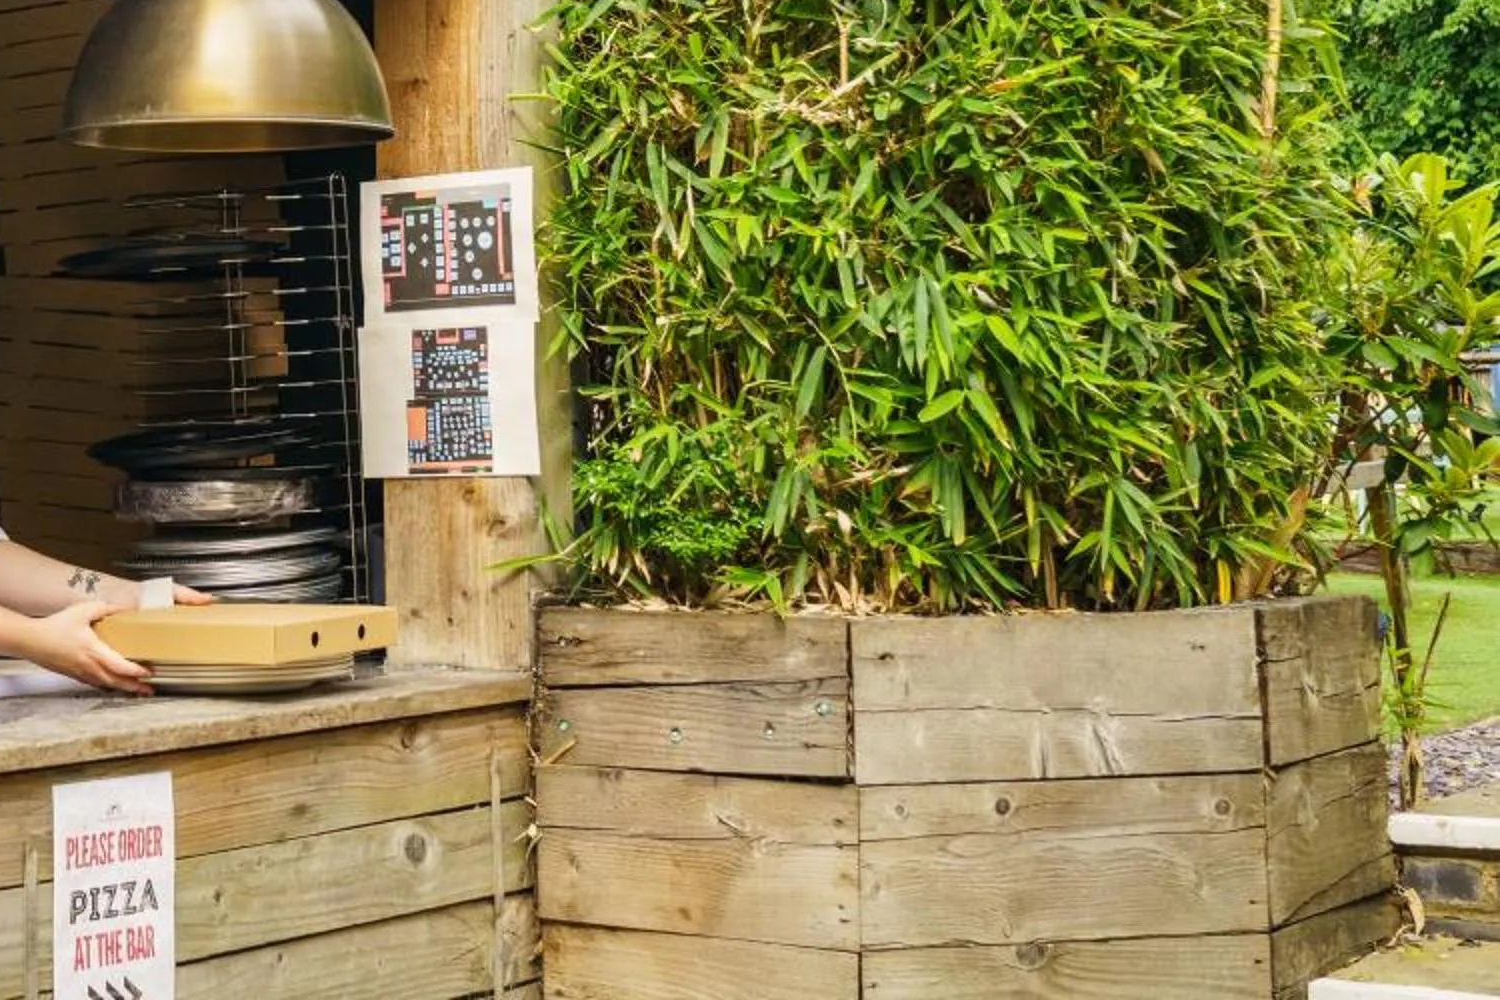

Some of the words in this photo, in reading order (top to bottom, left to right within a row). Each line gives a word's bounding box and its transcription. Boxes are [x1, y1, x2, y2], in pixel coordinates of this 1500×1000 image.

[65, 831, 116, 871] PLEASE
[117, 824, 164, 862] ORDER
[68, 878, 160, 925] PIZZA
[73, 935, 93, 971] AT
[95, 929, 123, 968] THE
[126, 925, 156, 962] BAR
